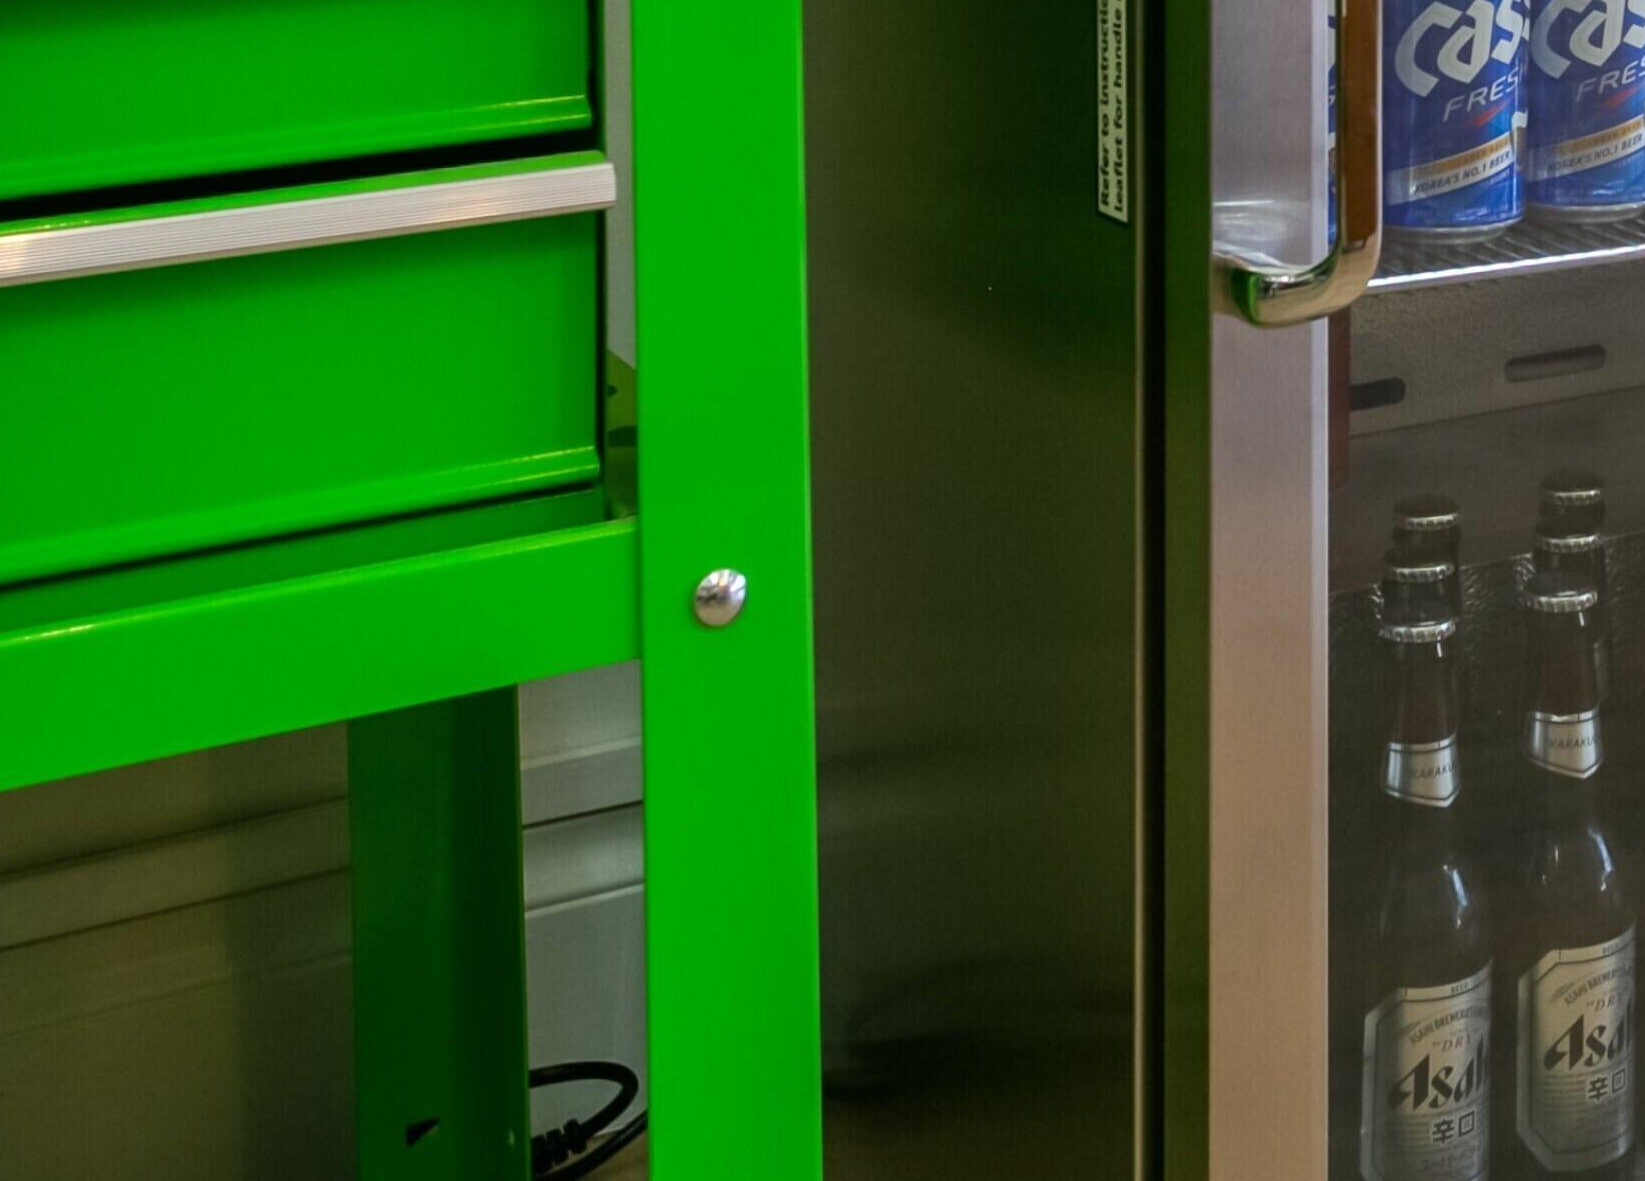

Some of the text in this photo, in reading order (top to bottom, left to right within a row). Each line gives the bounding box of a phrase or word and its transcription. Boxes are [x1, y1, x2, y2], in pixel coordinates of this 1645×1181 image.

[1111, 7, 1123, 89] handle
[1099, 114, 1110, 138] to
[1112, 98, 1124, 130] for
[1099, 145, 1110, 208] Refer
[1112, 136, 1124, 213] leaflet
